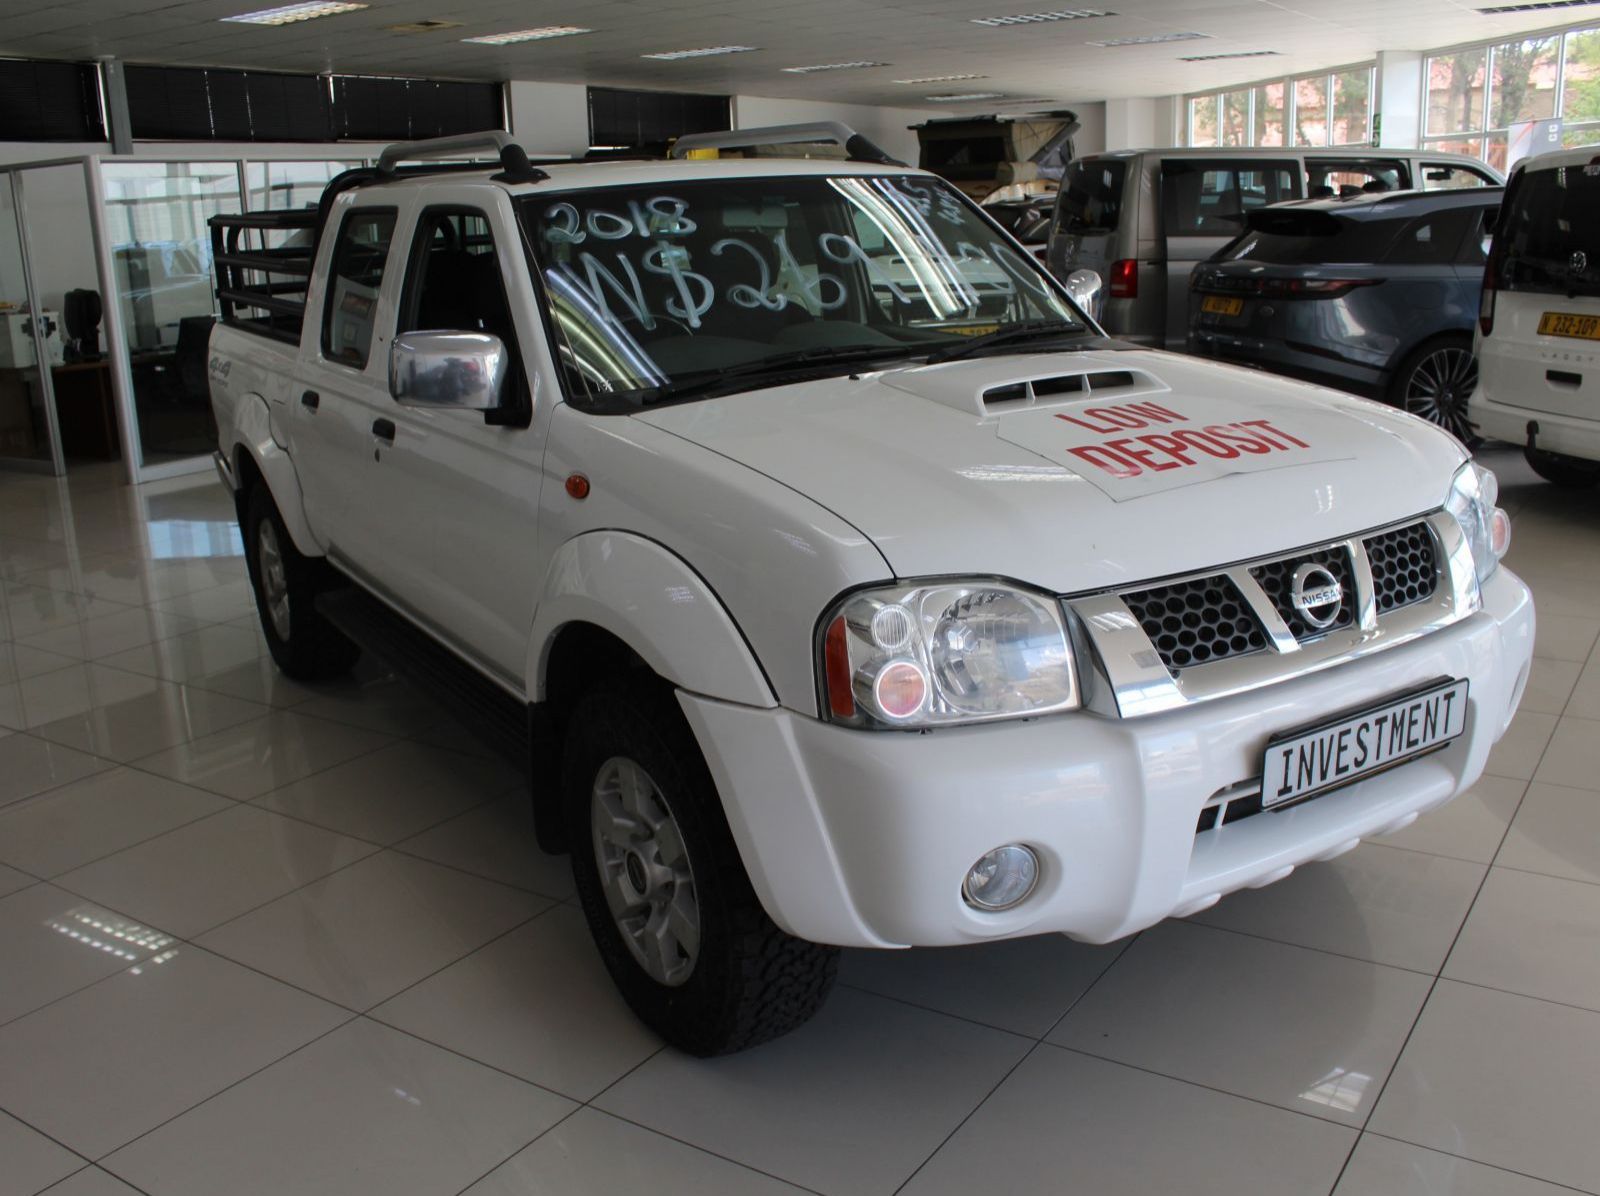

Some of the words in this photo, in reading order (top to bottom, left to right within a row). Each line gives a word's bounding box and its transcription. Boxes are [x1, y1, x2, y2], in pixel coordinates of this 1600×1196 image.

[543, 196, 697, 245] 2018
[1054, 401, 1190, 435] LOW
[1066, 419, 1312, 480] DEPOSIT
[1301, 588, 1342, 605] NISSAN
[1277, 690, 1456, 797] INVESTMENT
